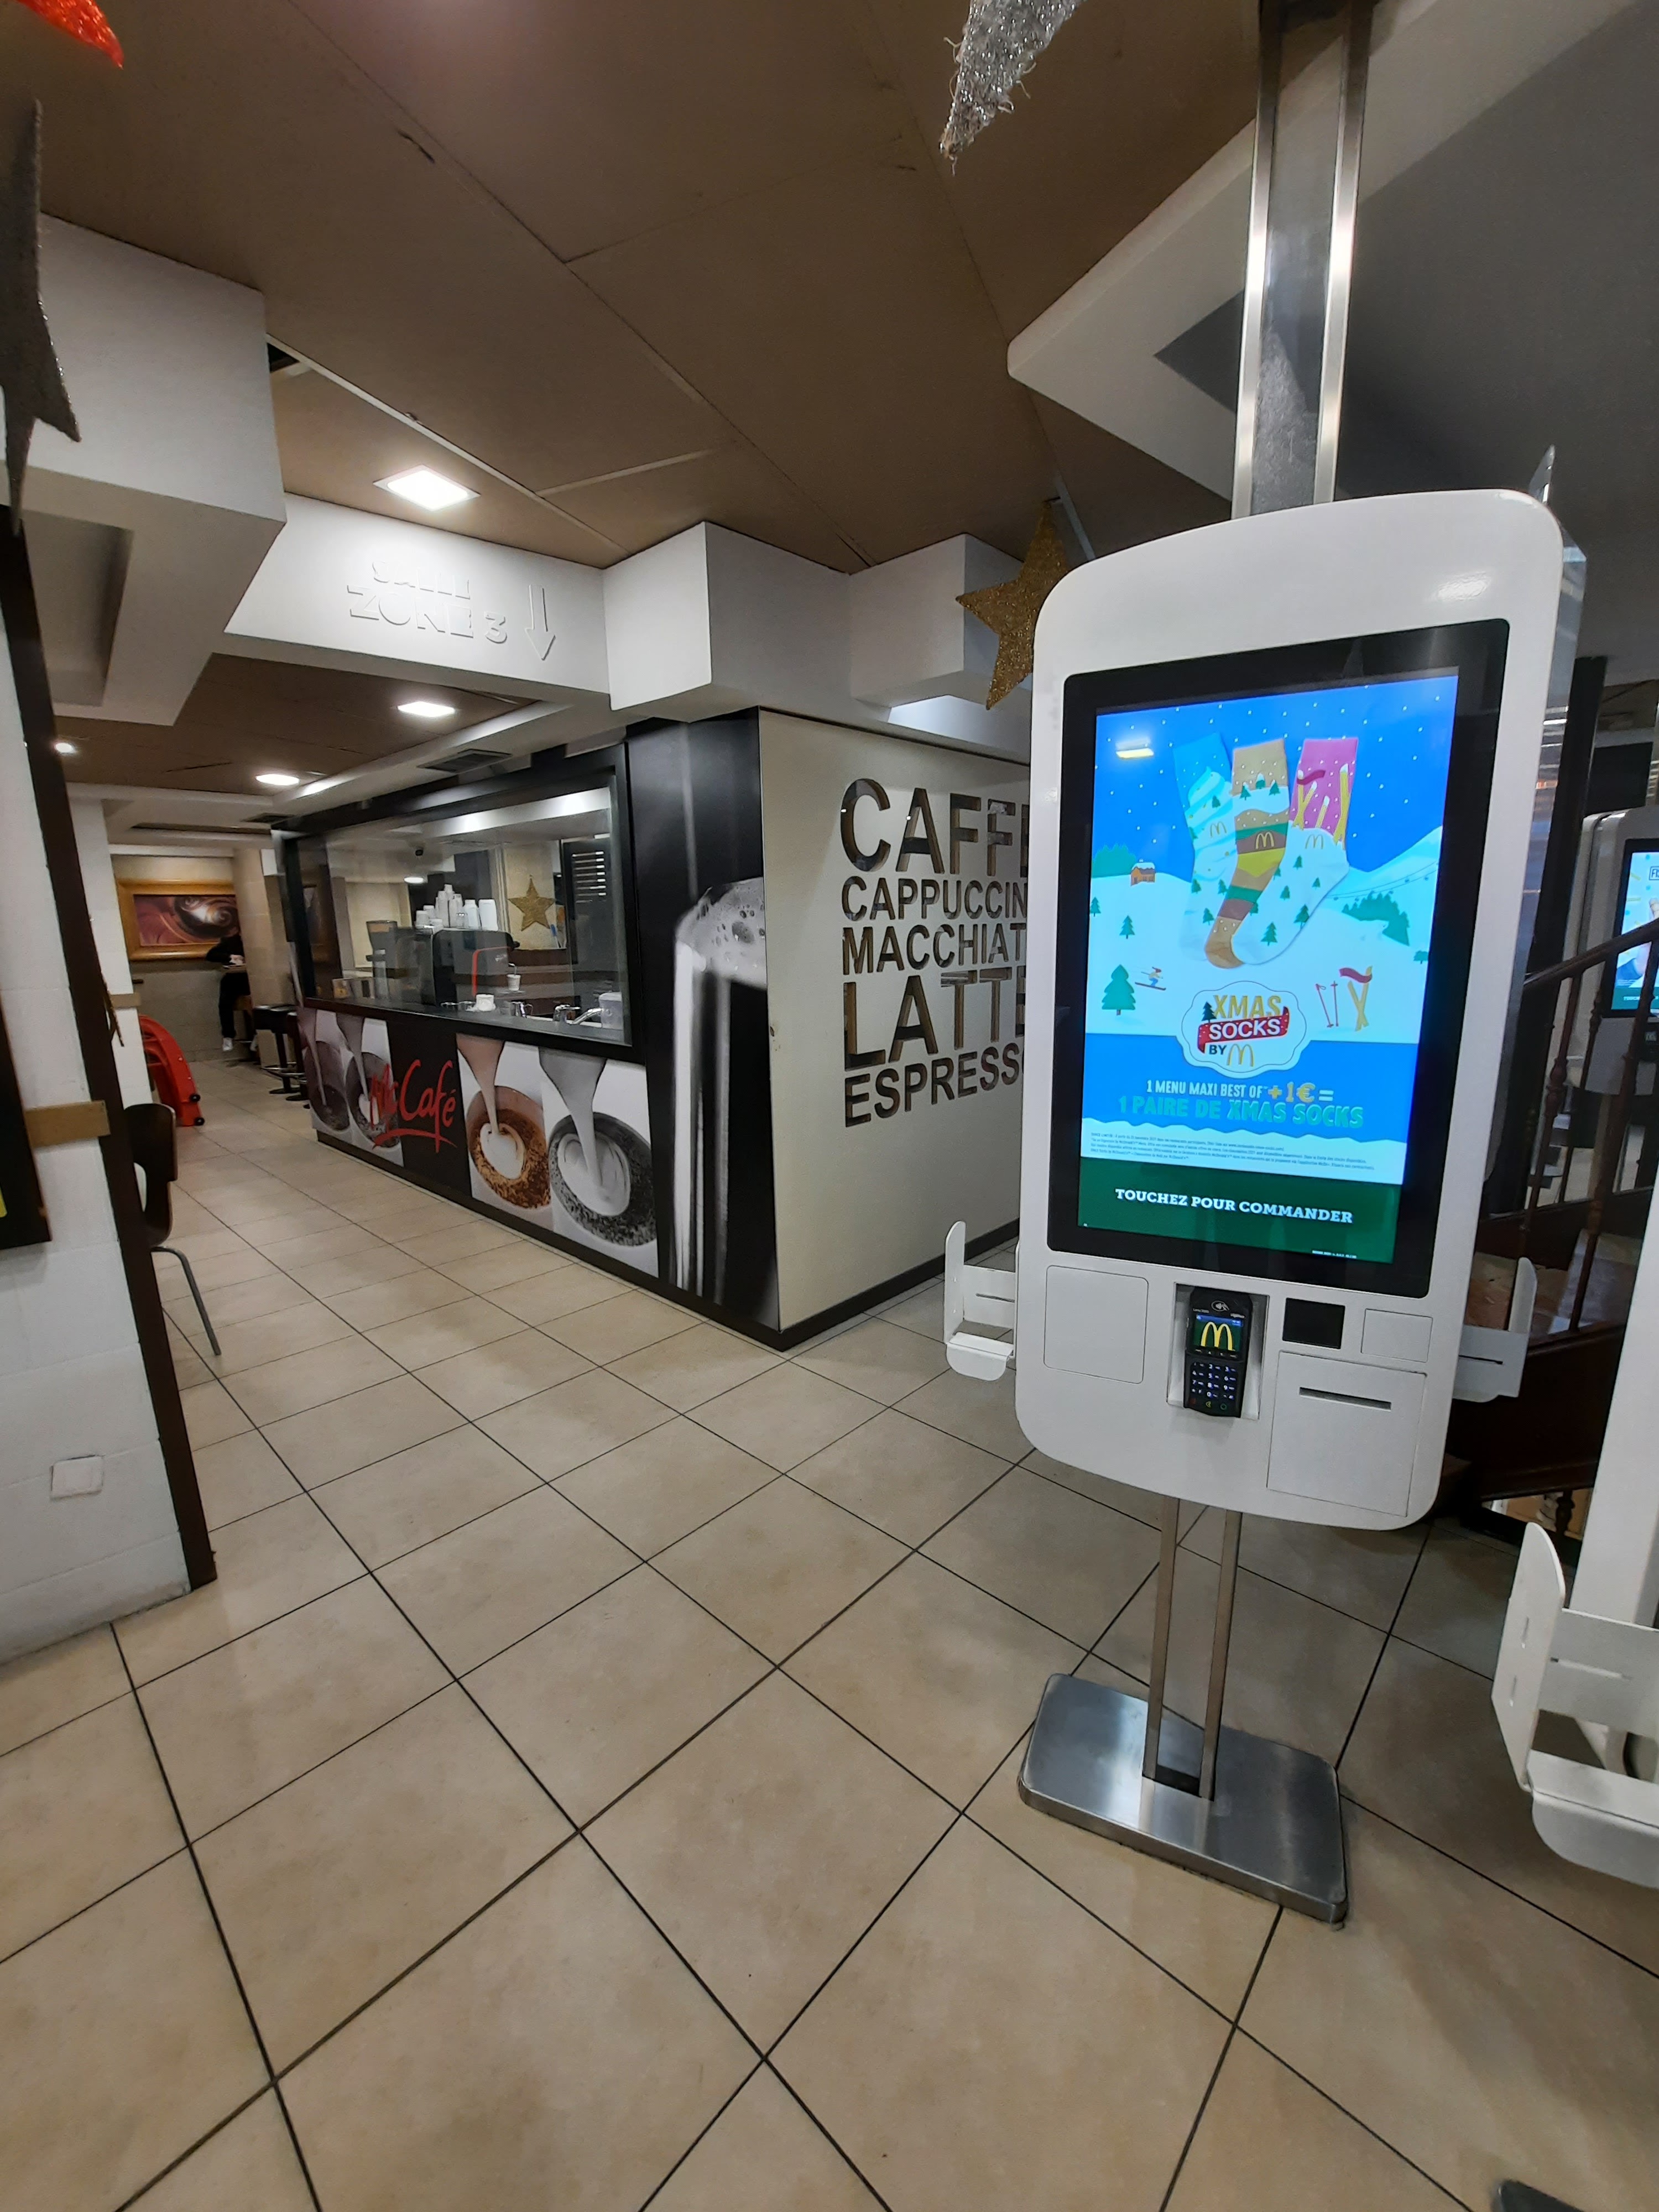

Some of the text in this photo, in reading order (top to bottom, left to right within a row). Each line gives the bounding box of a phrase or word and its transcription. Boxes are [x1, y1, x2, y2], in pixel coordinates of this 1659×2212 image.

[484, 611, 508, 644] 3
[1213, 995, 1281, 1019] XMAS
[1208, 1019, 1281, 1040] SOCKS
[1209, 1045, 1227, 1055] BY
[844, 1042, 1025, 1128] ESPRESS
[1146, 1079, 1152, 1093] 1
[1155, 1081, 1186, 1094] MENU
[1189, 1083, 1217, 1096] MAXI
[1220, 1084, 1245, 1098] BEST
[1119, 1096, 1364, 1128] 1 PAIRE DE XMAS SOCKS
[1115, 1188, 1353, 1223] TOUCHEZ POUR COMMANDER
